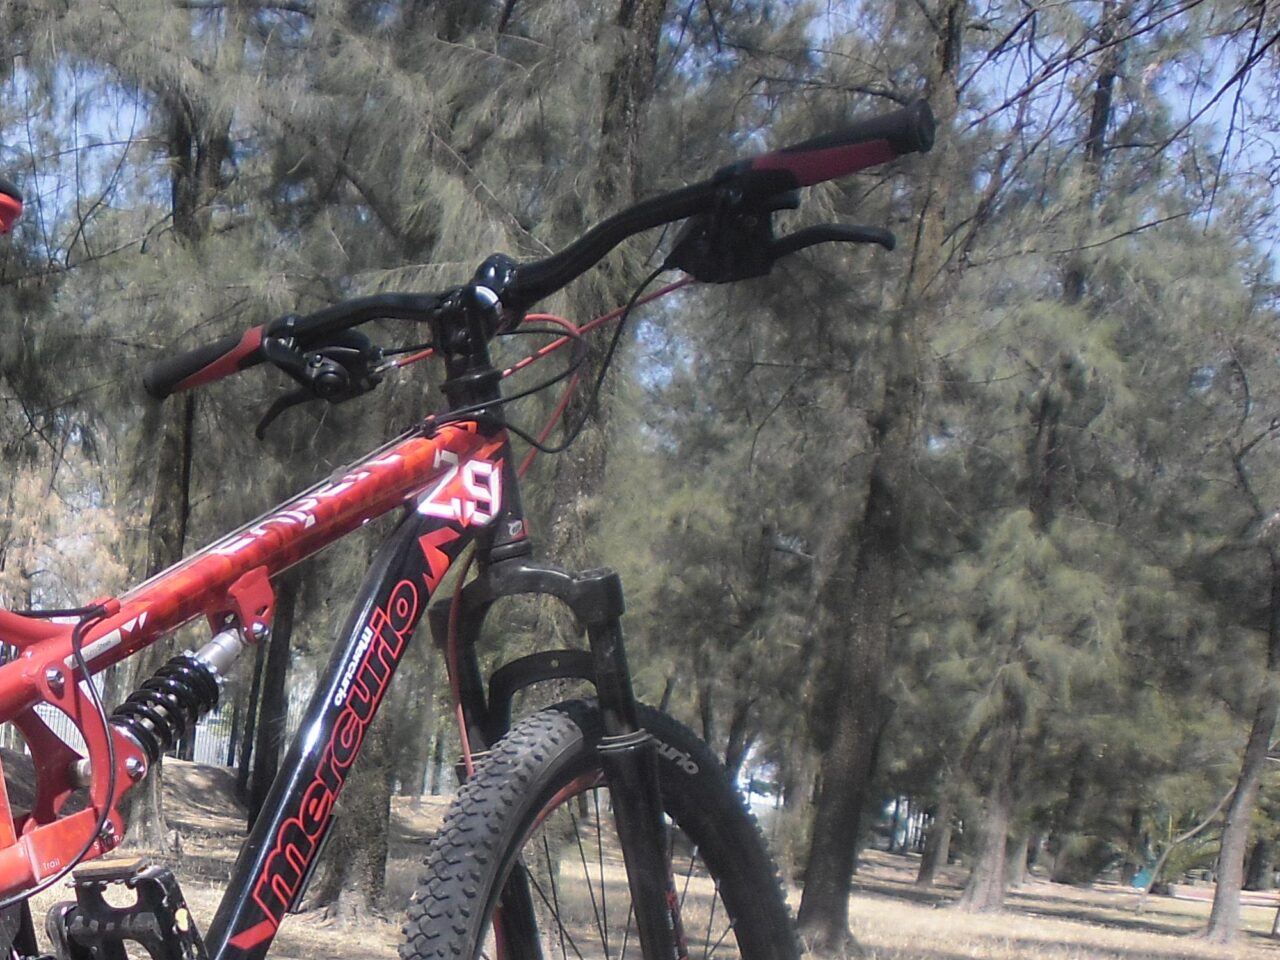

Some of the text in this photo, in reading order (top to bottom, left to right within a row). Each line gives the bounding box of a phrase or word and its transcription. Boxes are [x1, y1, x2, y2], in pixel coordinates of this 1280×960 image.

[417, 447, 501, 526] 29
[333, 625, 373, 707] mercurio
[253, 579, 418, 929] mercurio
[42, 857, 61, 872] Trail
